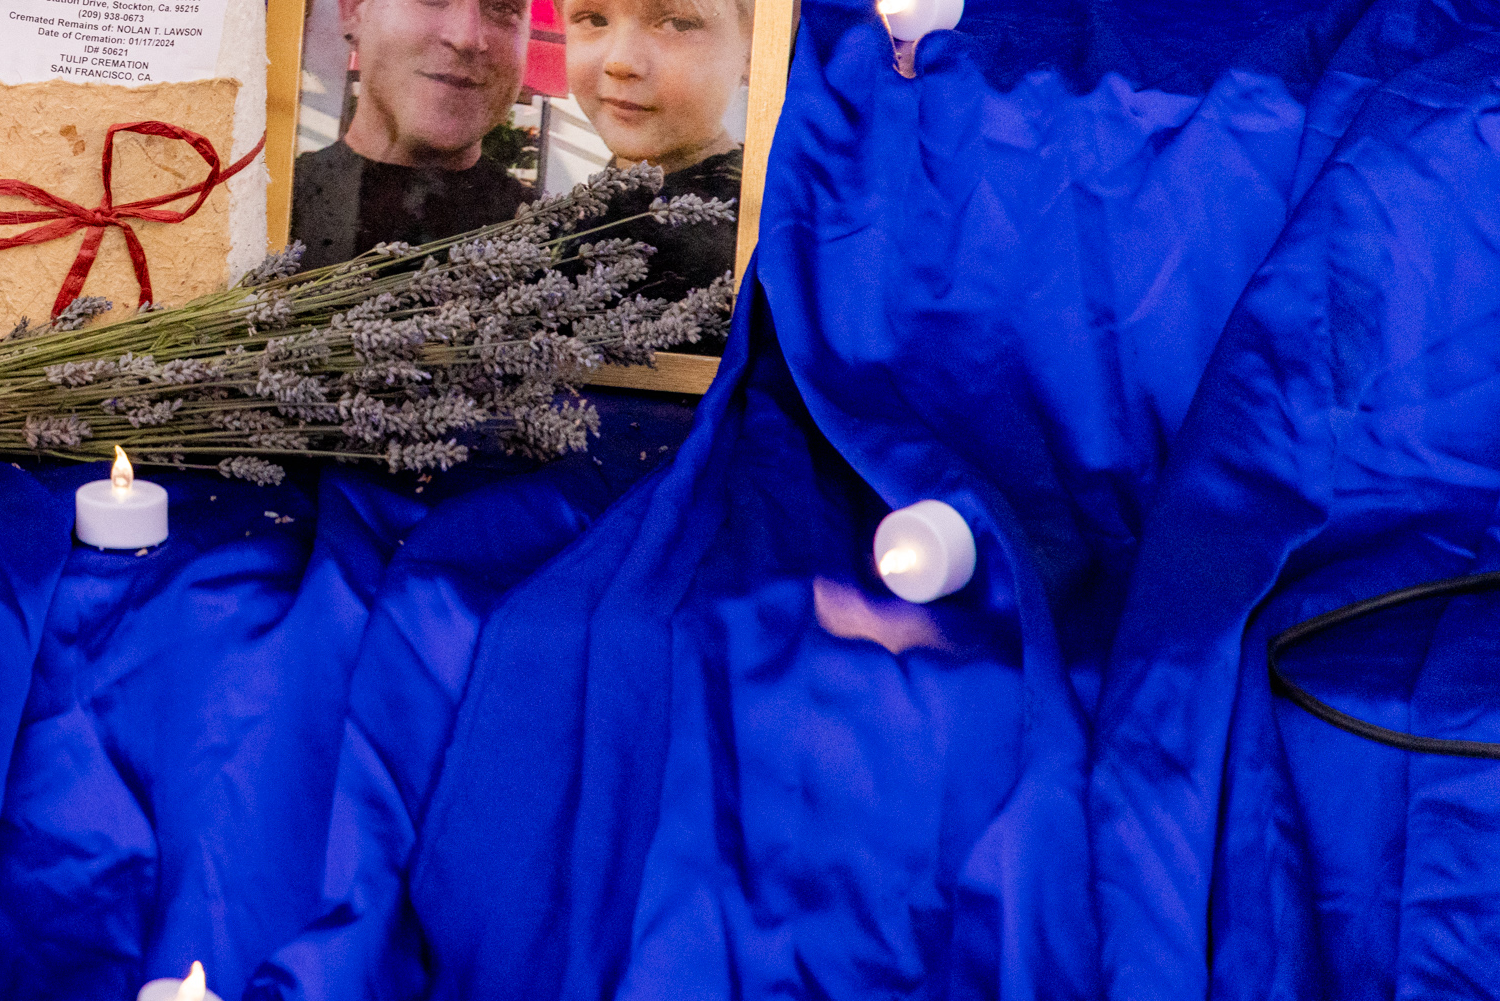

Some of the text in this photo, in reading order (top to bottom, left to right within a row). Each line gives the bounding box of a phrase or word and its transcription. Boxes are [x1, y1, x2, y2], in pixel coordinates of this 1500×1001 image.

[112, 0, 156, 14] Stockton,
[158, 3, 172, 13] Ca.
[174, 4, 200, 13] 95215
[9, 11, 203, 37] Cremated Remains of: NOLAN T. LAWSON
[78, 9, 145, 23] (209) 938-0673
[38, 27, 175, 47] Date of Cremation: 01/17/2024
[84, 45, 129, 57] ID# 50621
[60, 53, 149, 70] TULIP CREMATION
[51, 64, 153, 82] SAN FRANCISCO, CA.
